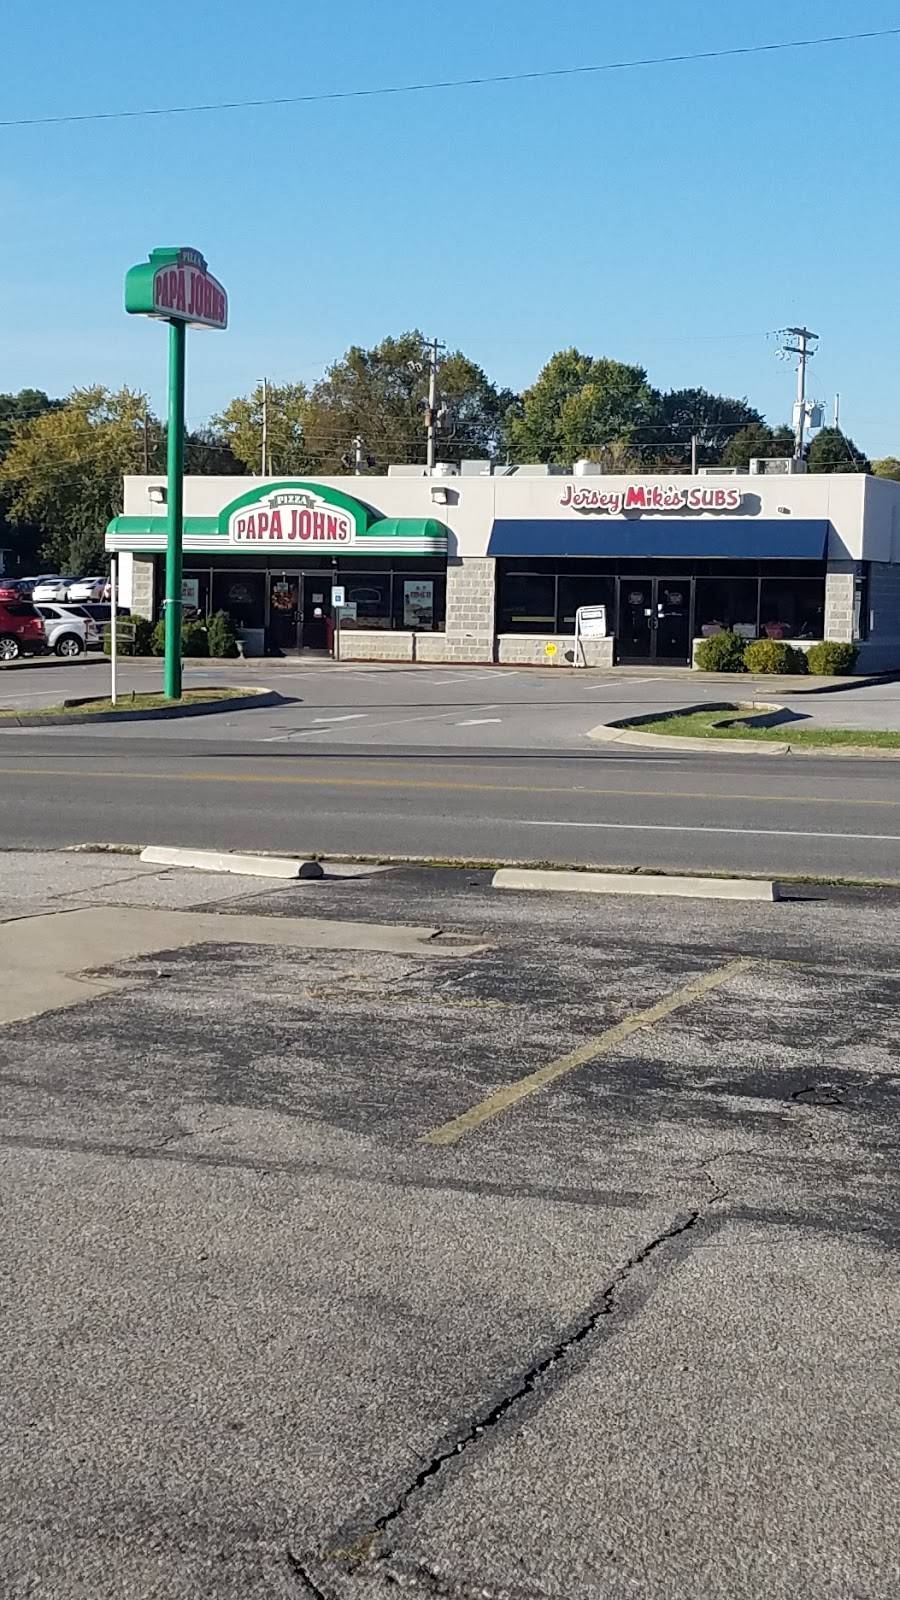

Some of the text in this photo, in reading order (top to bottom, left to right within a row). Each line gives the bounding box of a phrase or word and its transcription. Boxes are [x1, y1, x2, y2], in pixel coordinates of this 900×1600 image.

[155, 270, 186, 312] PAPA
[276, 495, 308, 505] PIZZA
[560, 485, 738, 512] Jersey Mike's SUBS
[237, 510, 283, 540] PAPA
